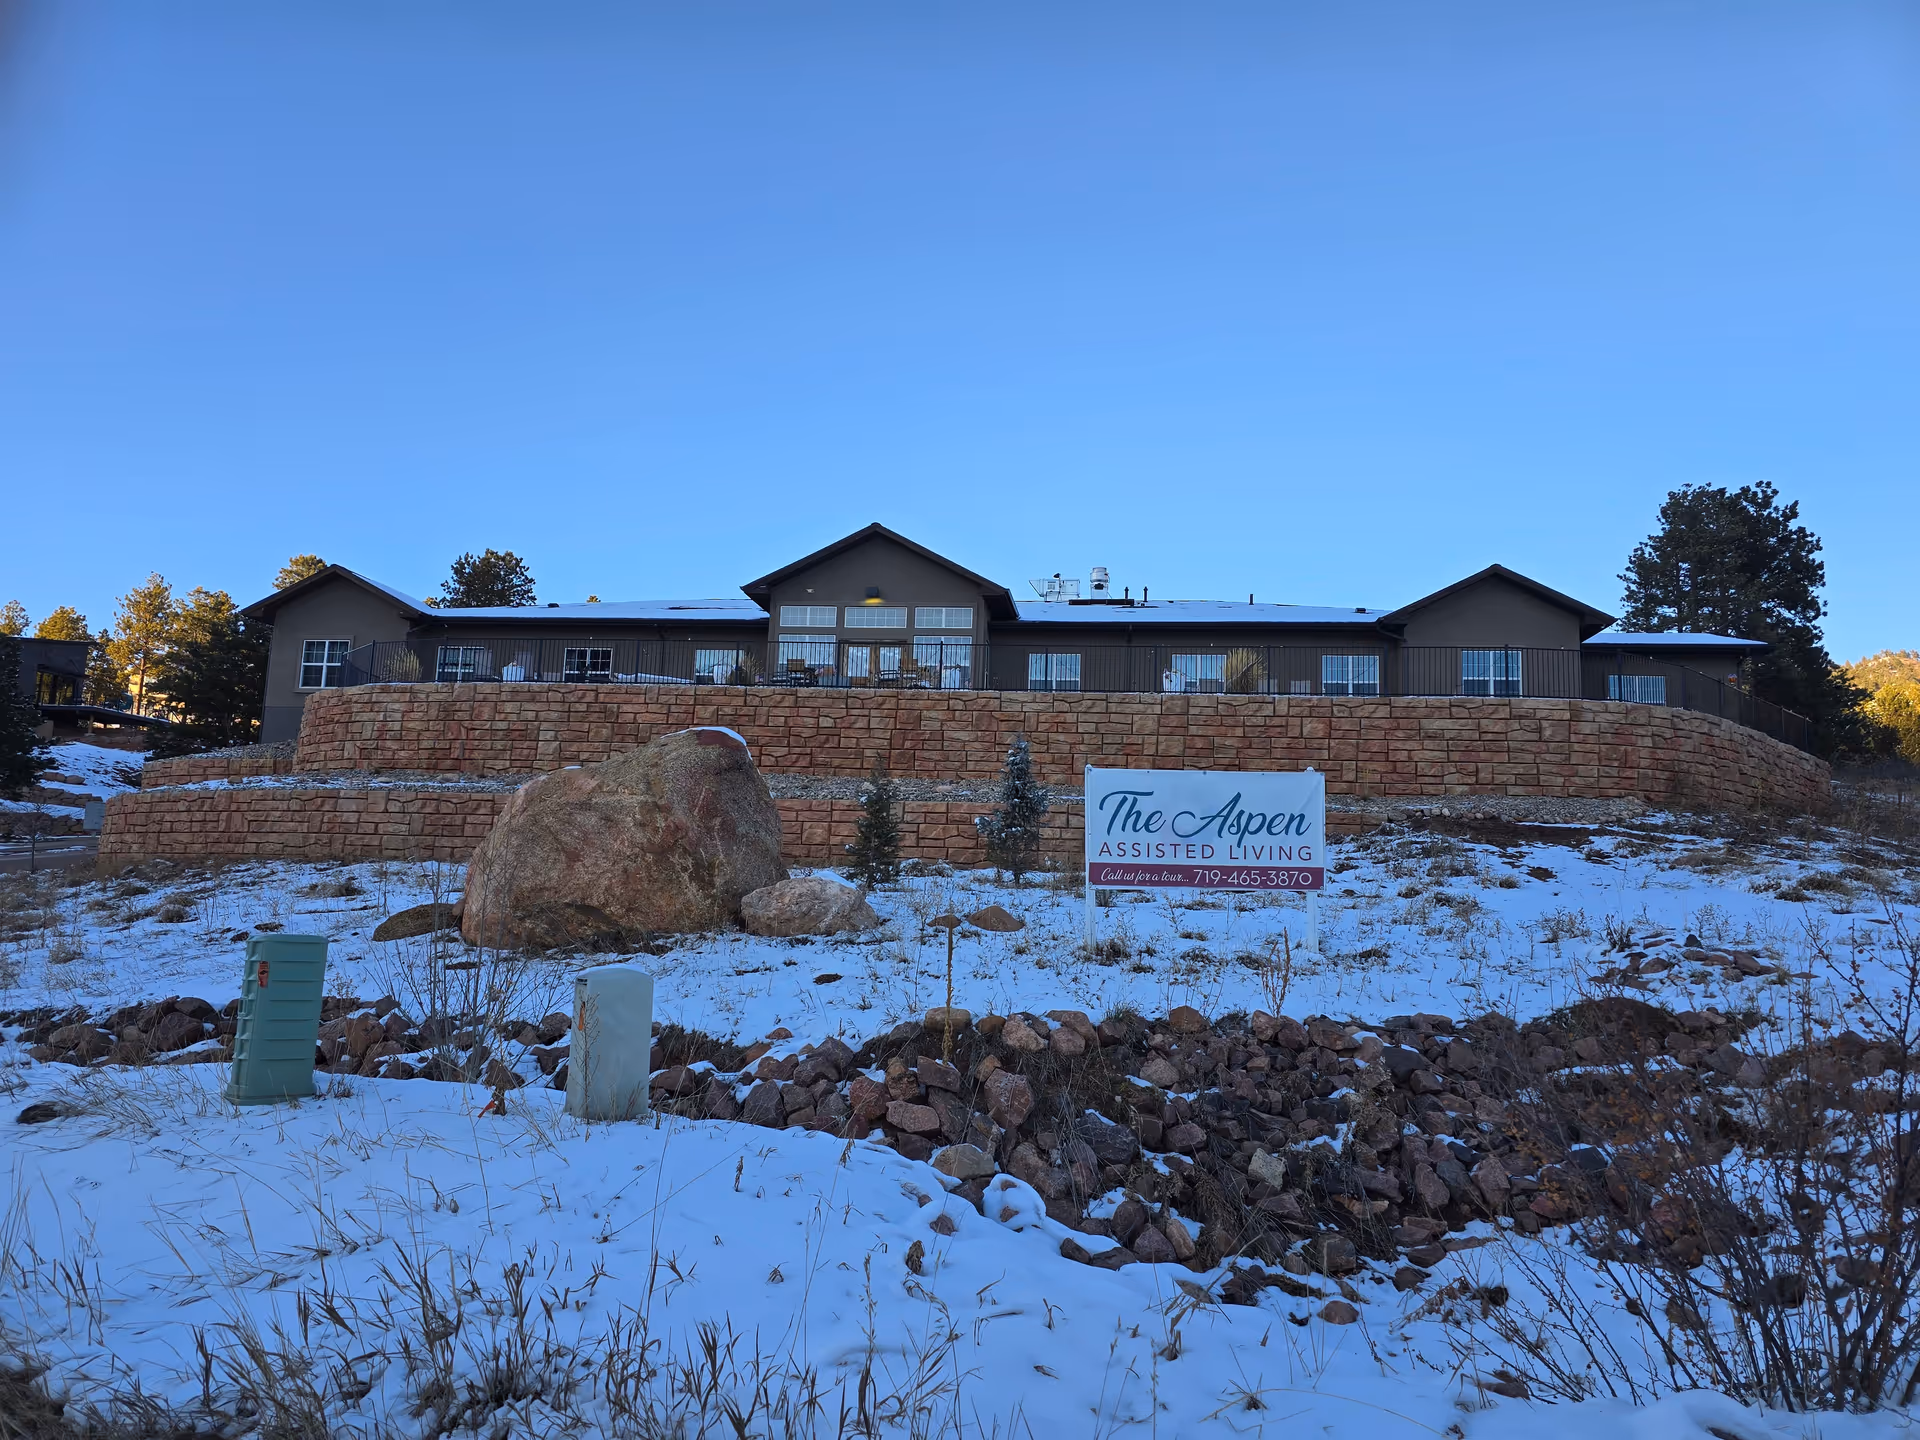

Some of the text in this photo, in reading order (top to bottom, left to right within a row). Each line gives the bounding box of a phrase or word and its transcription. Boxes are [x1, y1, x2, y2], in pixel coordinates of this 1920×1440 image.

[1099, 790, 1312, 849] The Aspen
[1098, 841, 1312, 861] ASSISTED LIVING
[1101, 867, 1312, 886] Call us for a tour... 719-465-3870
